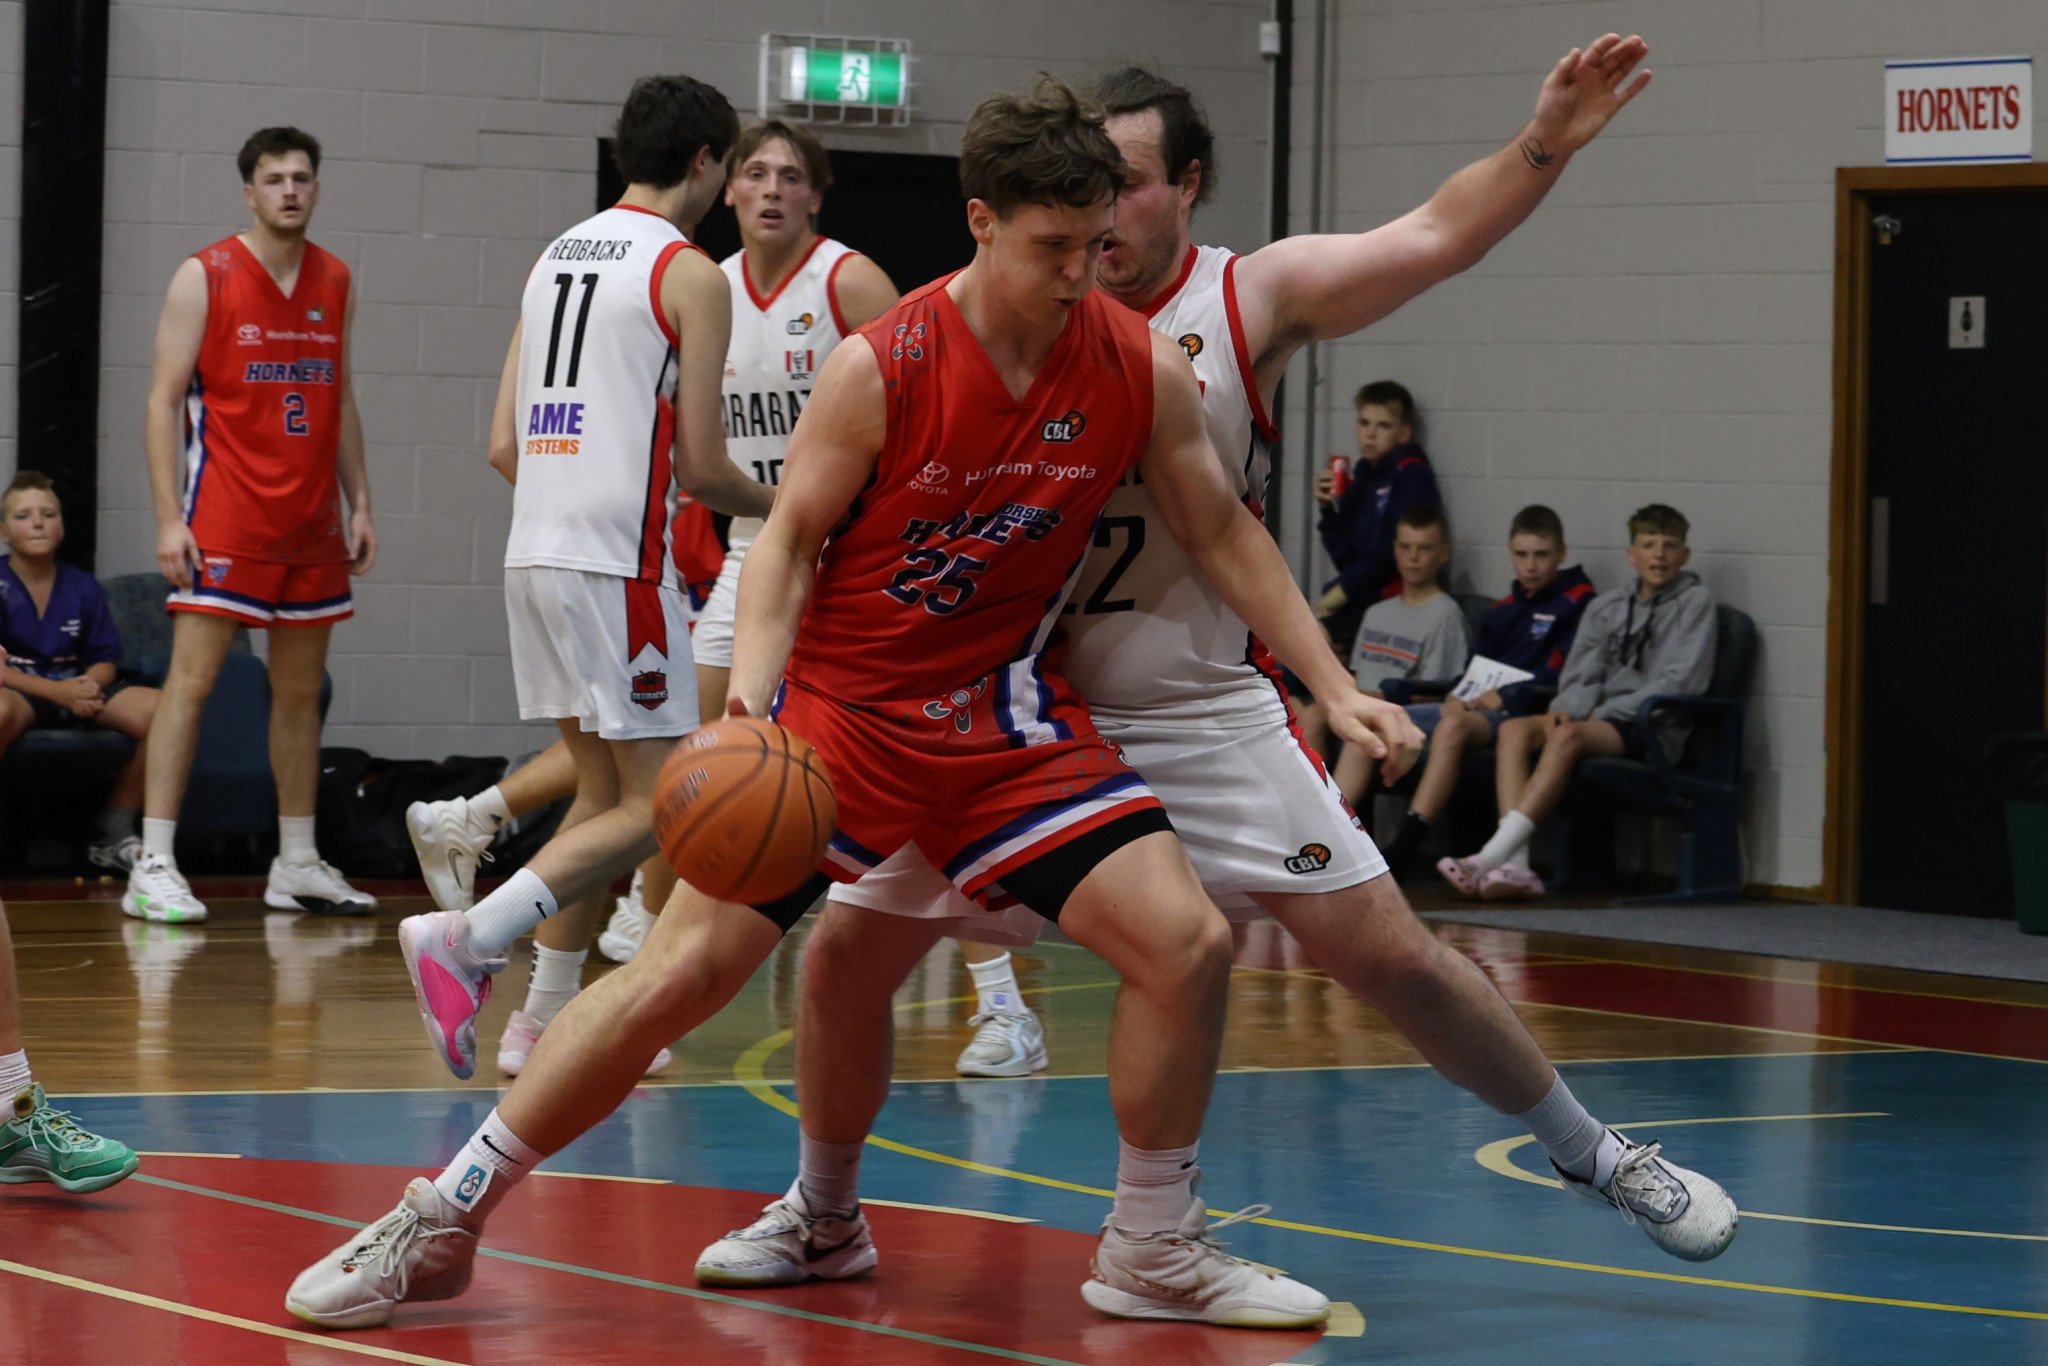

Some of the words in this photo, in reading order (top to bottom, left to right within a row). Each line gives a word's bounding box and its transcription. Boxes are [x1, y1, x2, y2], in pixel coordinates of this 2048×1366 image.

[1896, 85, 2020, 133] HORNETS
[549, 239, 632, 261] REDBACKS
[543, 273, 600, 388] 11
[244, 362, 335, 384] HORNETS
[283, 392, 309, 436] 2
[528, 403, 585, 436] AME
[1042, 422, 1072, 440] CBL
[526, 438, 580, 456] SYSTEMS
[1037, 461, 1097, 482] Toyota
[907, 481, 948, 496] OYOTA
[1064, 515, 1146, 615] 2
[882, 547, 990, 616] 25
[1287, 855, 1323, 873] CBL
